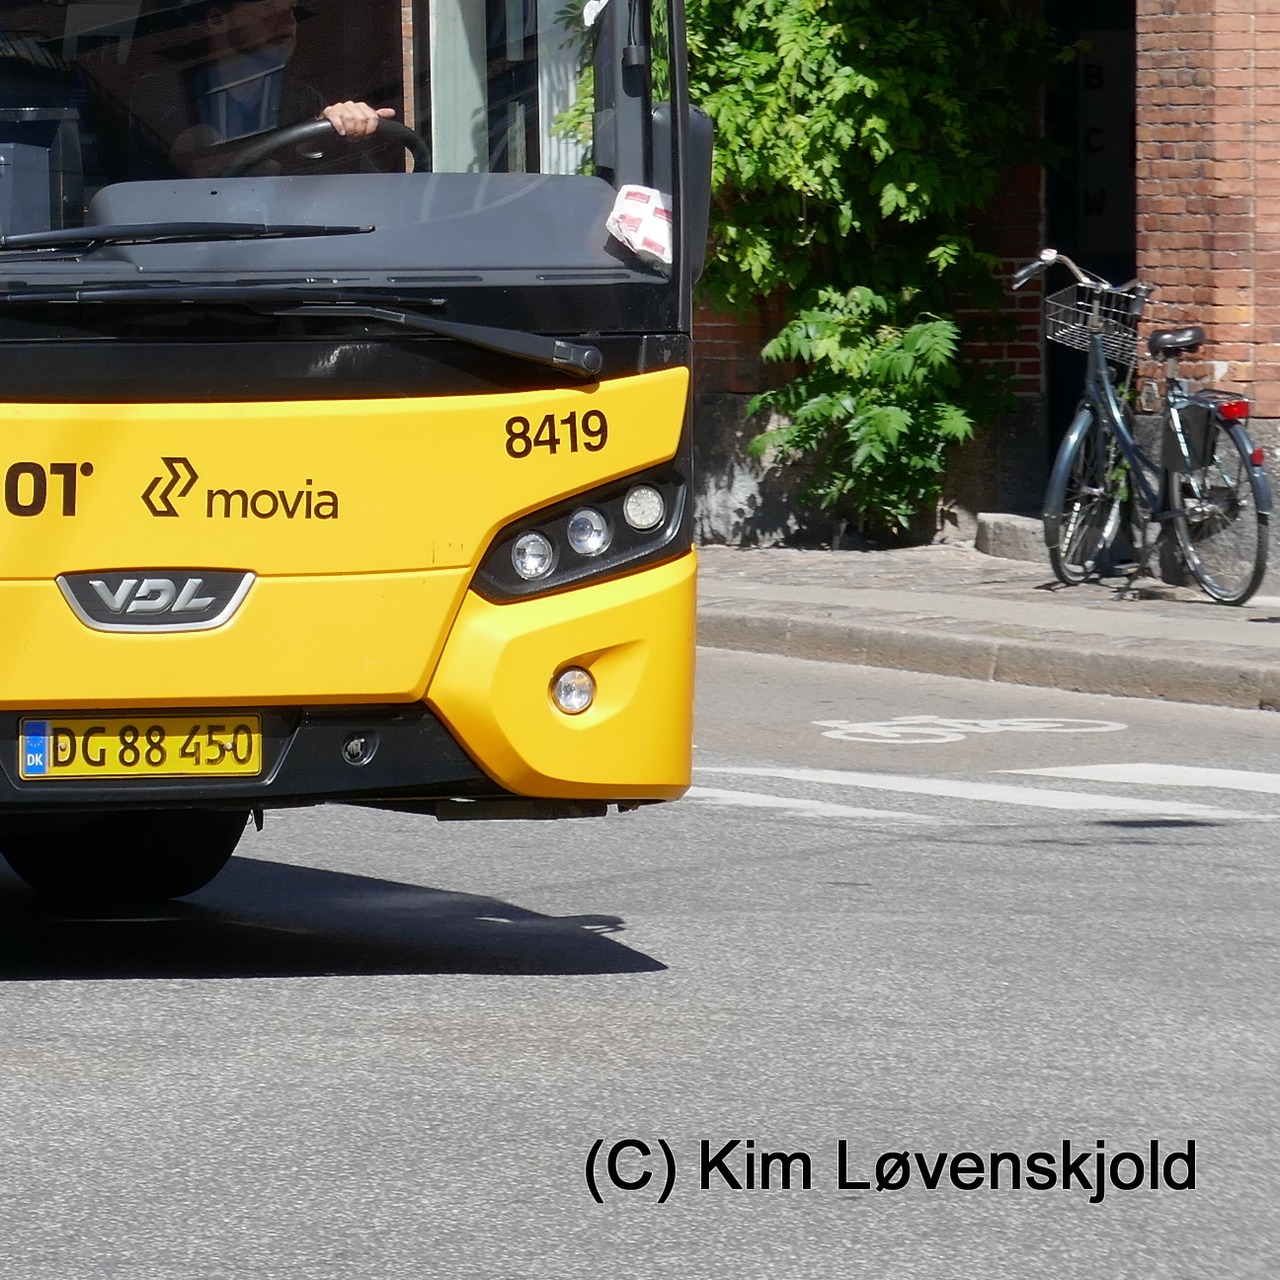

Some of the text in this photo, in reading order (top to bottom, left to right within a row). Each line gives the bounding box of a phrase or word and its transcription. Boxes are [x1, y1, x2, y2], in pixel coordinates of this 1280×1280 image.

[505, 409, 609, 459] 8419
[206, 478, 340, 521] movia
[88, 577, 217, 614] VDL
[26, 753, 43, 766] DK
[52, 723, 253, 768] DG 88 450
